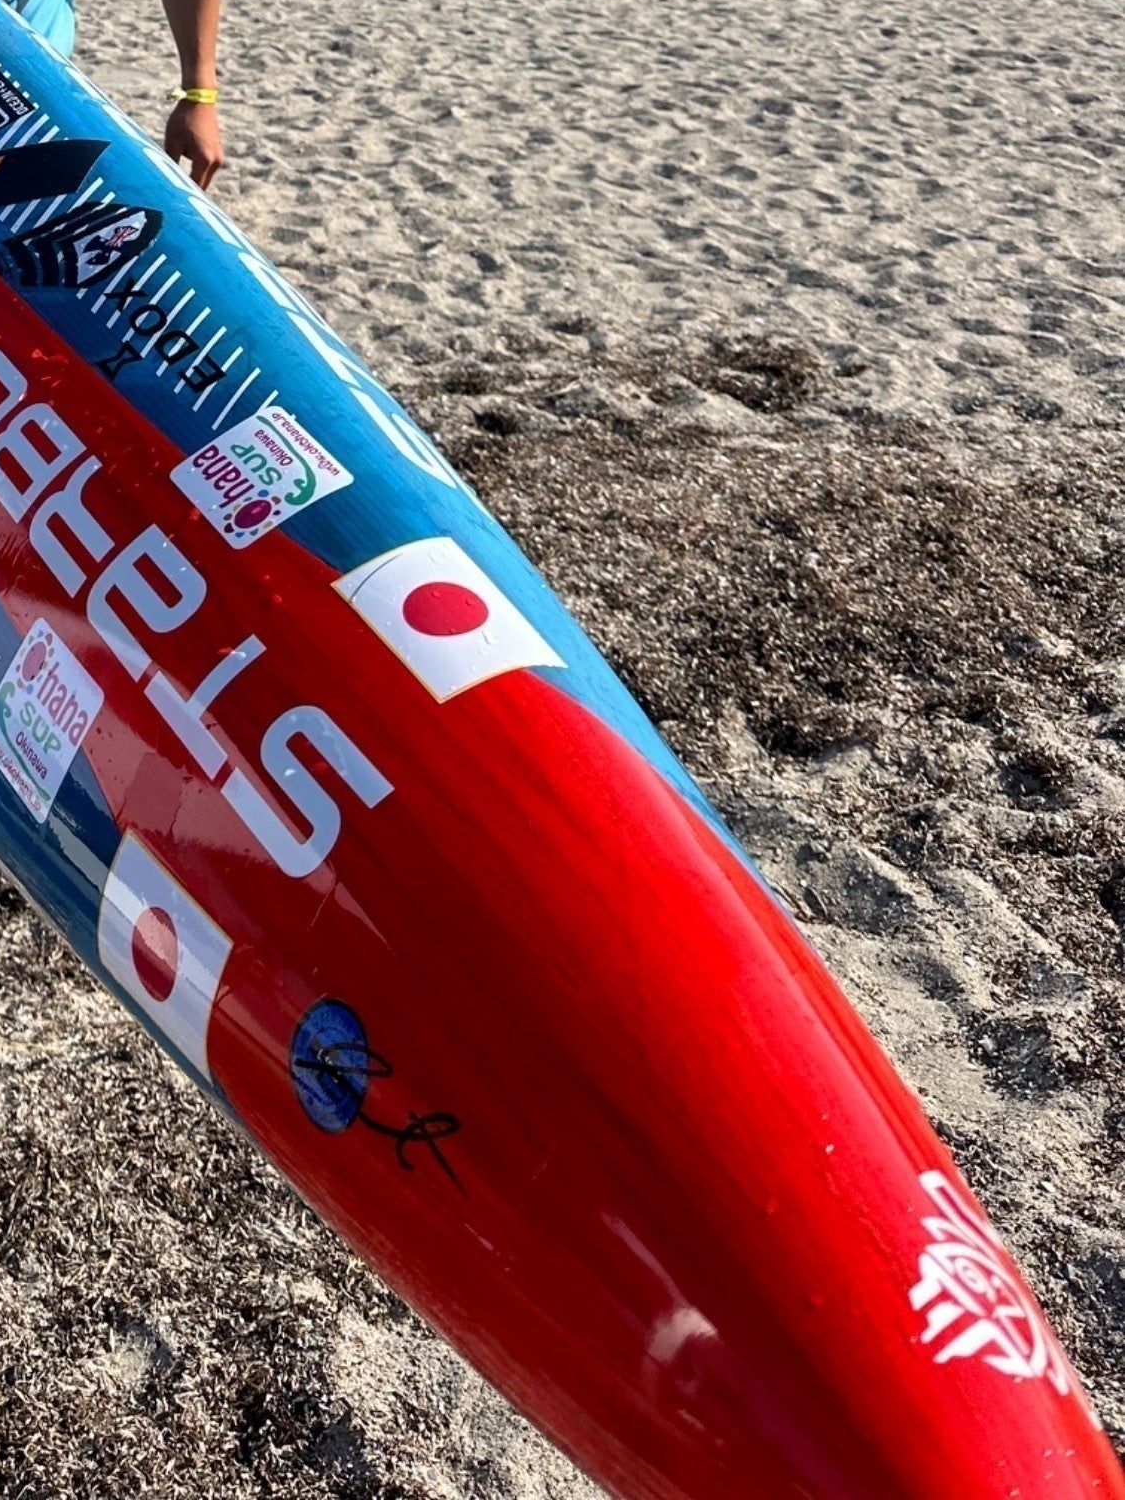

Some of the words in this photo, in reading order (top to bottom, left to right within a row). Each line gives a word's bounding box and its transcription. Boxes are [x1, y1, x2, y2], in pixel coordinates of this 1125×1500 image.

[103, 277, 227, 394] EDOX
[230, 444, 283, 486] SUP
[254, 429, 294, 467] Okinawa
[19, 700, 62, 754] SUP
[15, 731, 49, 780] Okinawa
